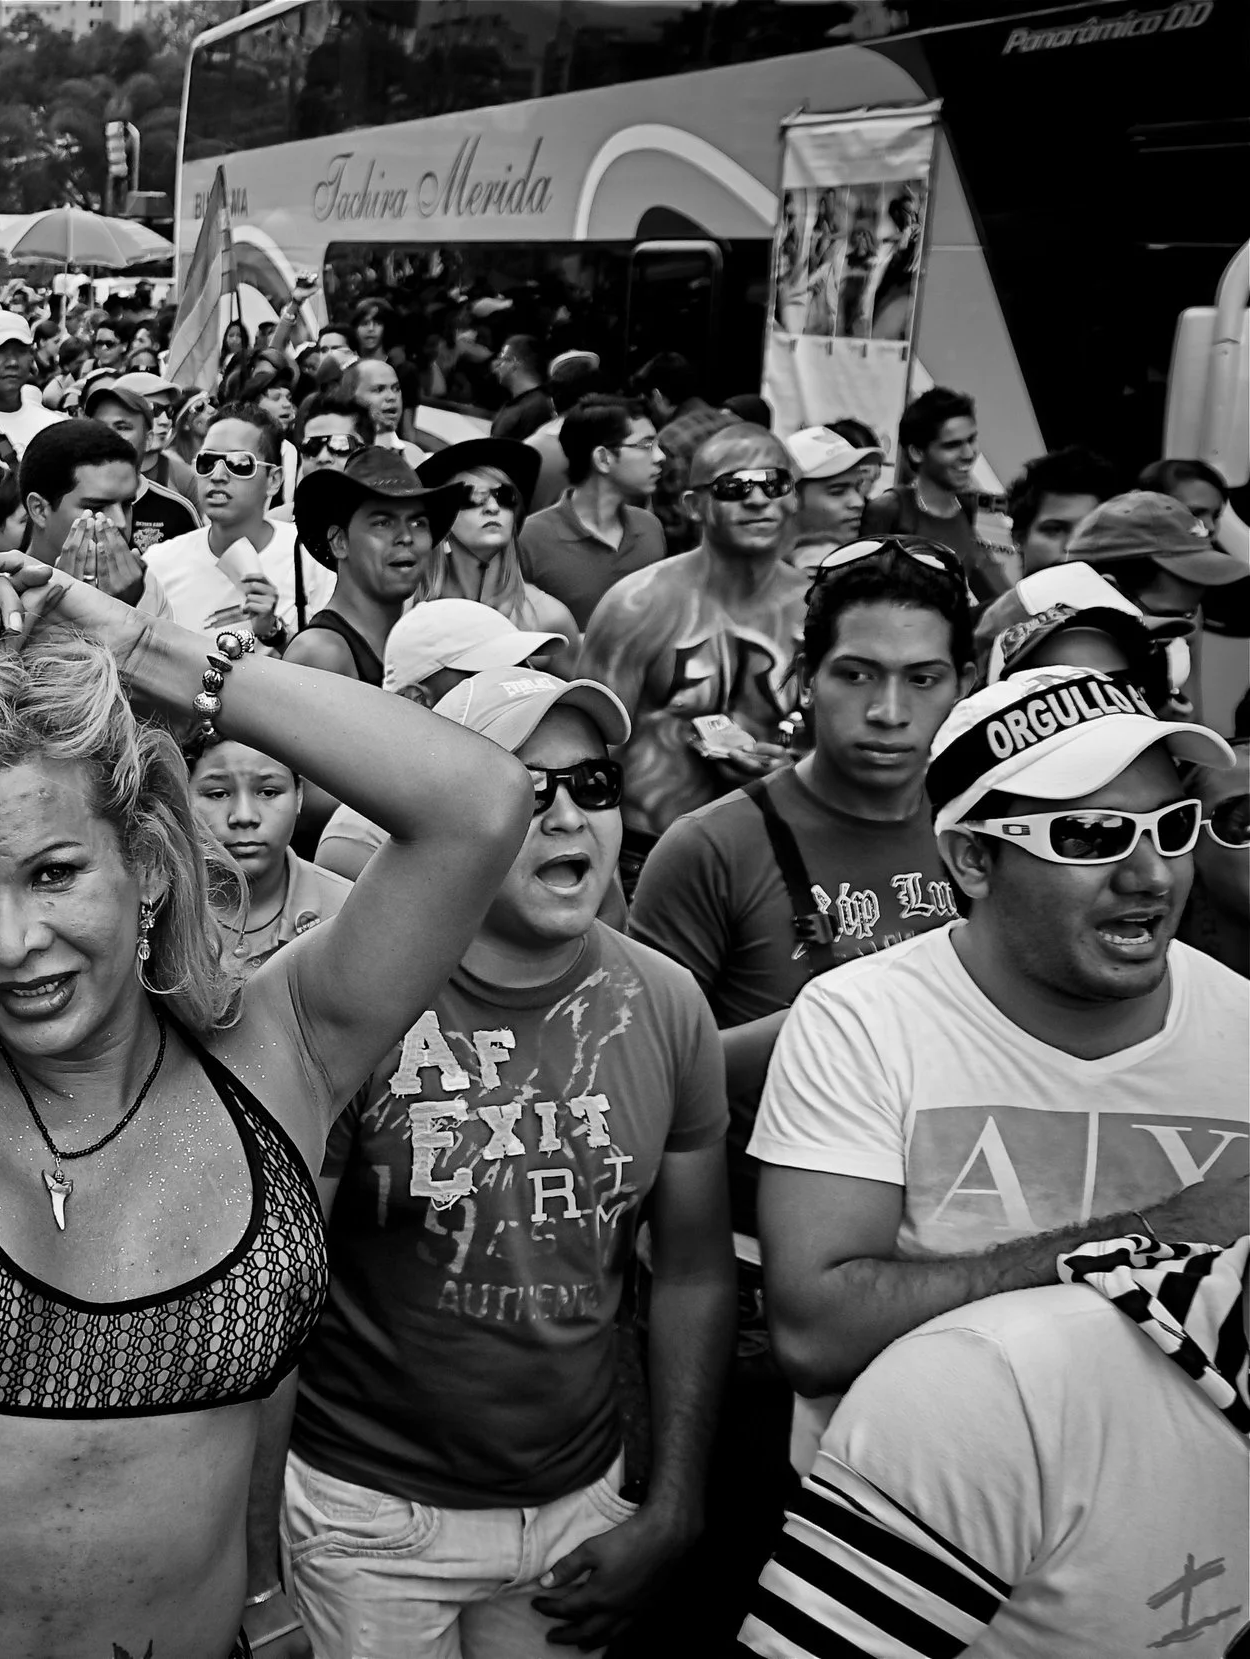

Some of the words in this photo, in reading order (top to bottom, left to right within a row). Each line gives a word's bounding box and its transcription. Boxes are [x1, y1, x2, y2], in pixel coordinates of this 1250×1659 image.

[417, 134, 553, 219] Merida
[985, 681, 1137, 759] ORGULLO
[407, 1093, 612, 1202] EXIT
